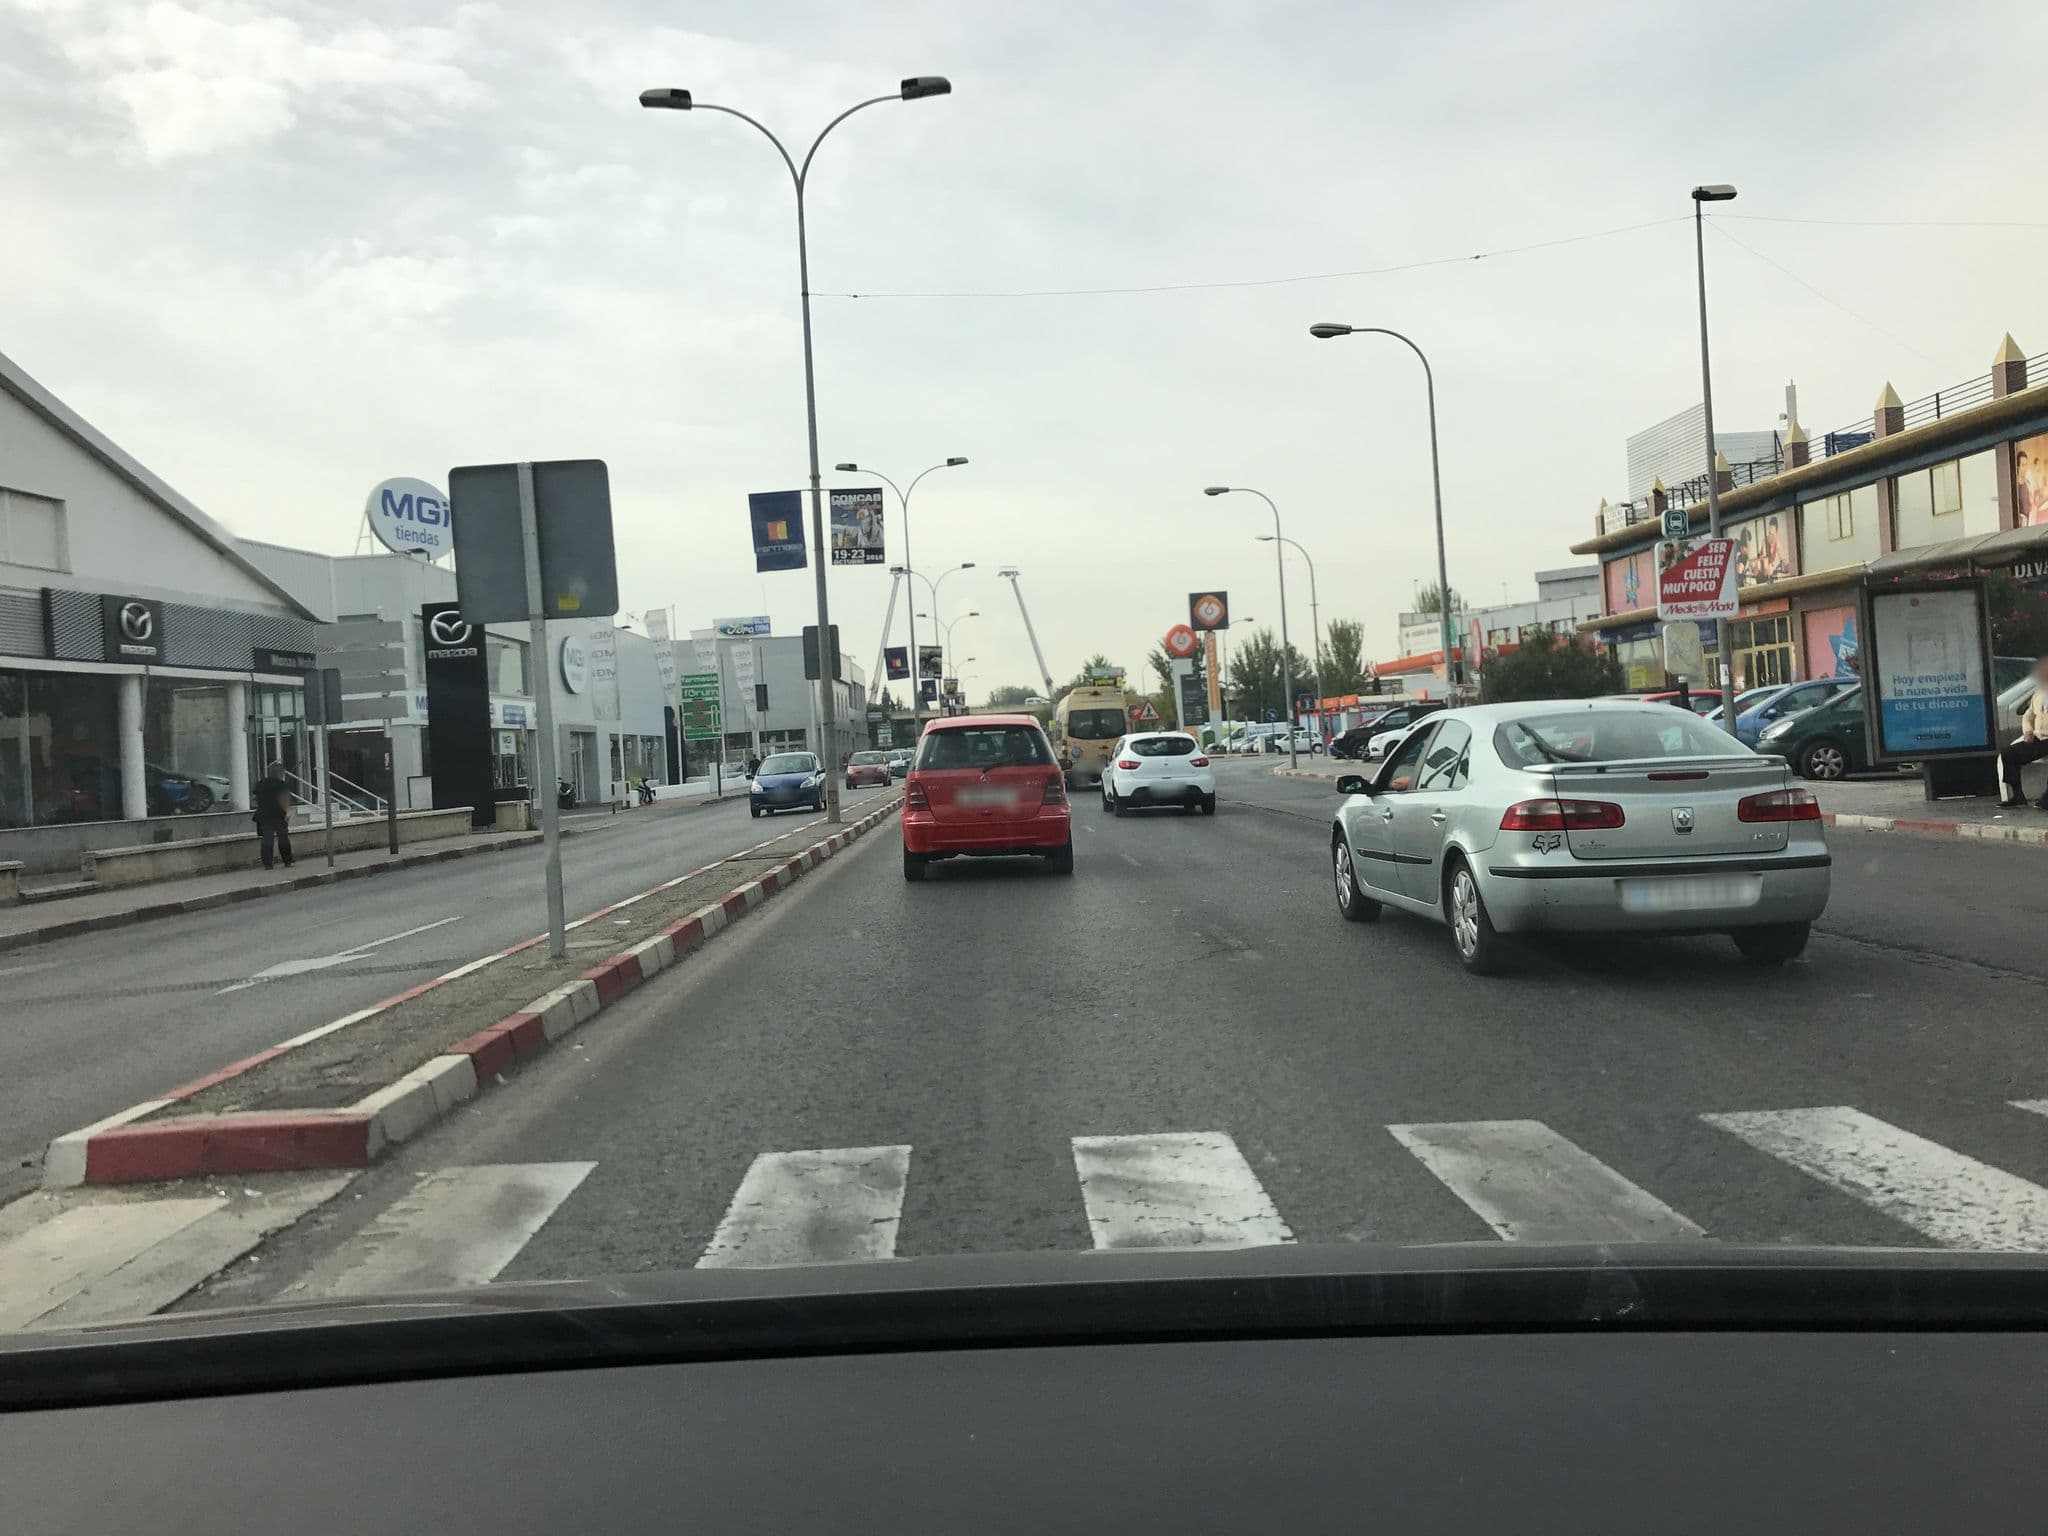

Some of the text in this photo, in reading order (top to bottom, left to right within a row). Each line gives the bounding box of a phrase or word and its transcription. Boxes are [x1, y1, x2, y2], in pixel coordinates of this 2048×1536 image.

[381, 488, 450, 528] MGi
[395, 524, 440, 547] tiendas
[834, 549, 865, 559] 19-23
[1708, 542, 1727, 554] SER
[1697, 554, 1725, 567] FELIZ
[1684, 567, 1720, 580] CUESTA
[1663, 580, 1716, 594] MUY POCO
[1665, 603, 1698, 616] Media
[727, 623, 754, 635] Ford
[428, 647, 479, 659] mazda
[1893, 672, 1967, 686] Hoy empieza
[1894, 684, 1968, 697] la nueva vida
[1895, 698, 1969, 712] de tu dinero
